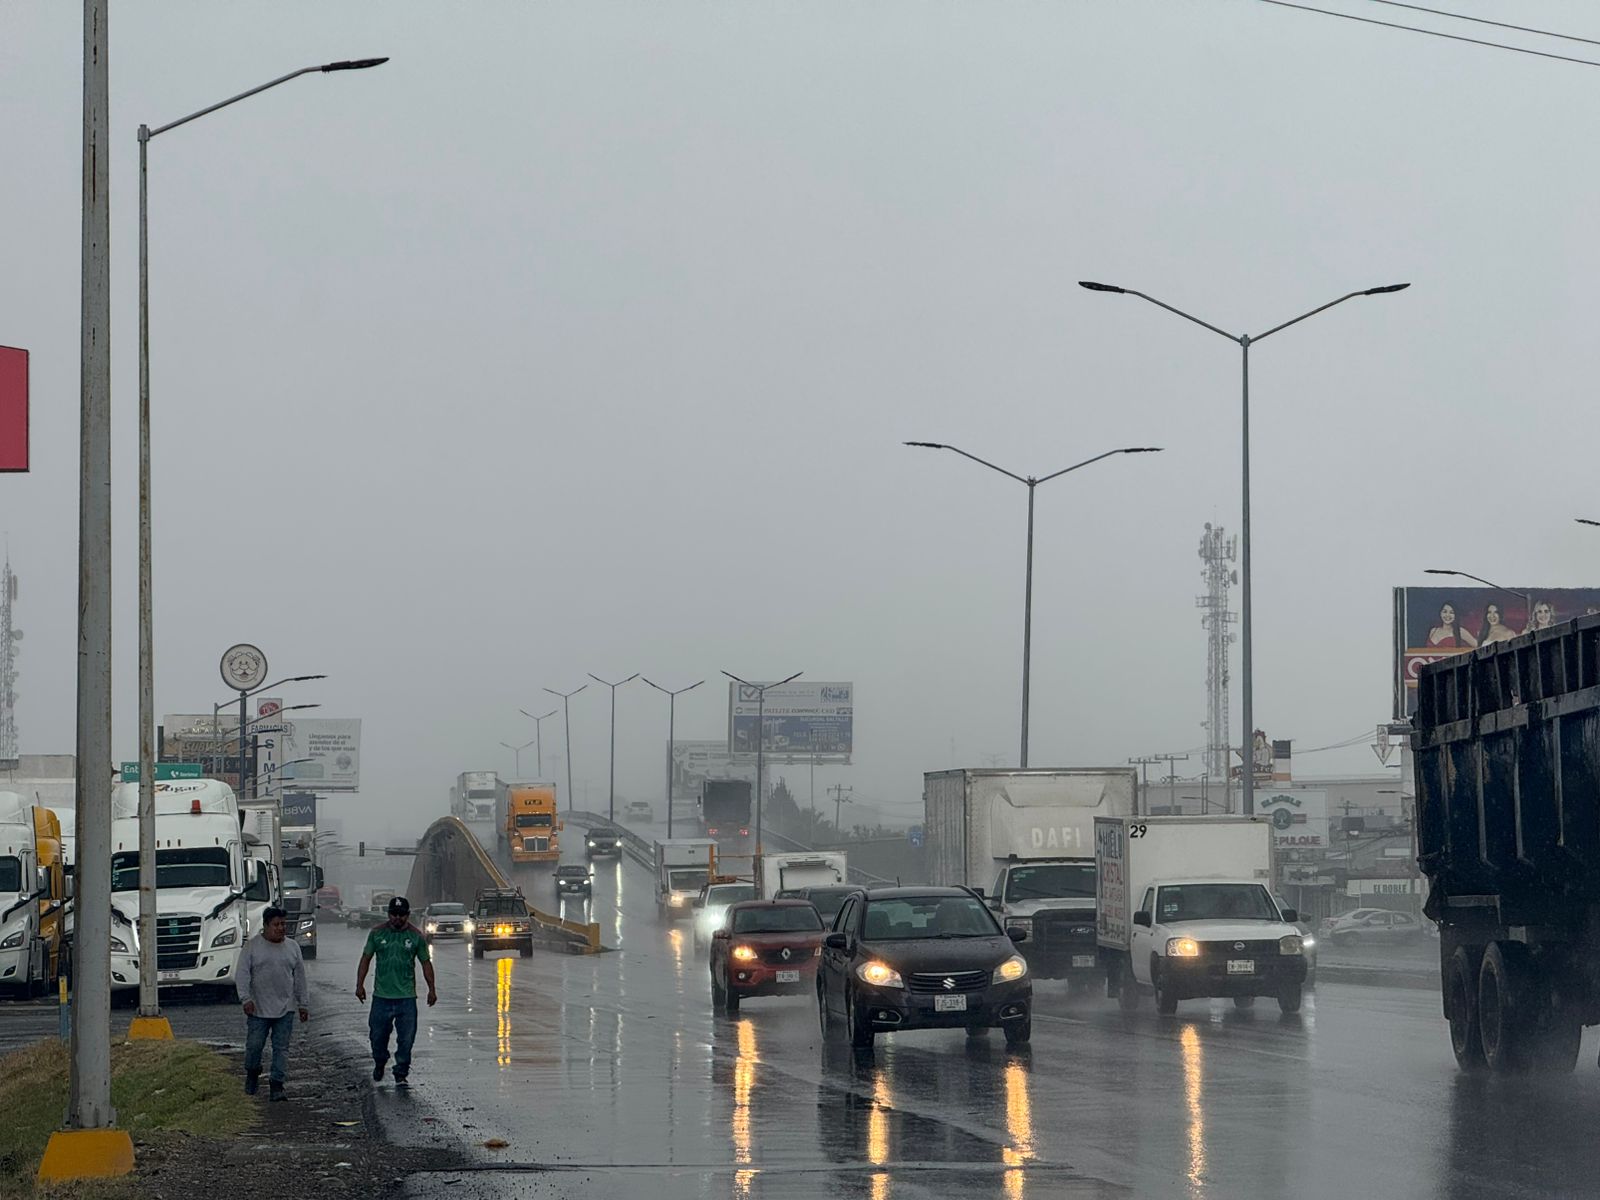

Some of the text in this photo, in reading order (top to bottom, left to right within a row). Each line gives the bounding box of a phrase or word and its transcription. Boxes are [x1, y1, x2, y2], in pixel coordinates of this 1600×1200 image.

[250, 724, 288, 734] FARMACIAS
[183, 741, 232, 753] SUBW
[124, 765, 158, 774] Enta
[284, 806, 313, 815] BBVA
[1129, 824, 1147, 838] 29
[1031, 827, 1081, 849] DAFI
[1280, 836, 1321, 846] PULQUE
[1373, 884, 1407, 894] EL ROBLE
